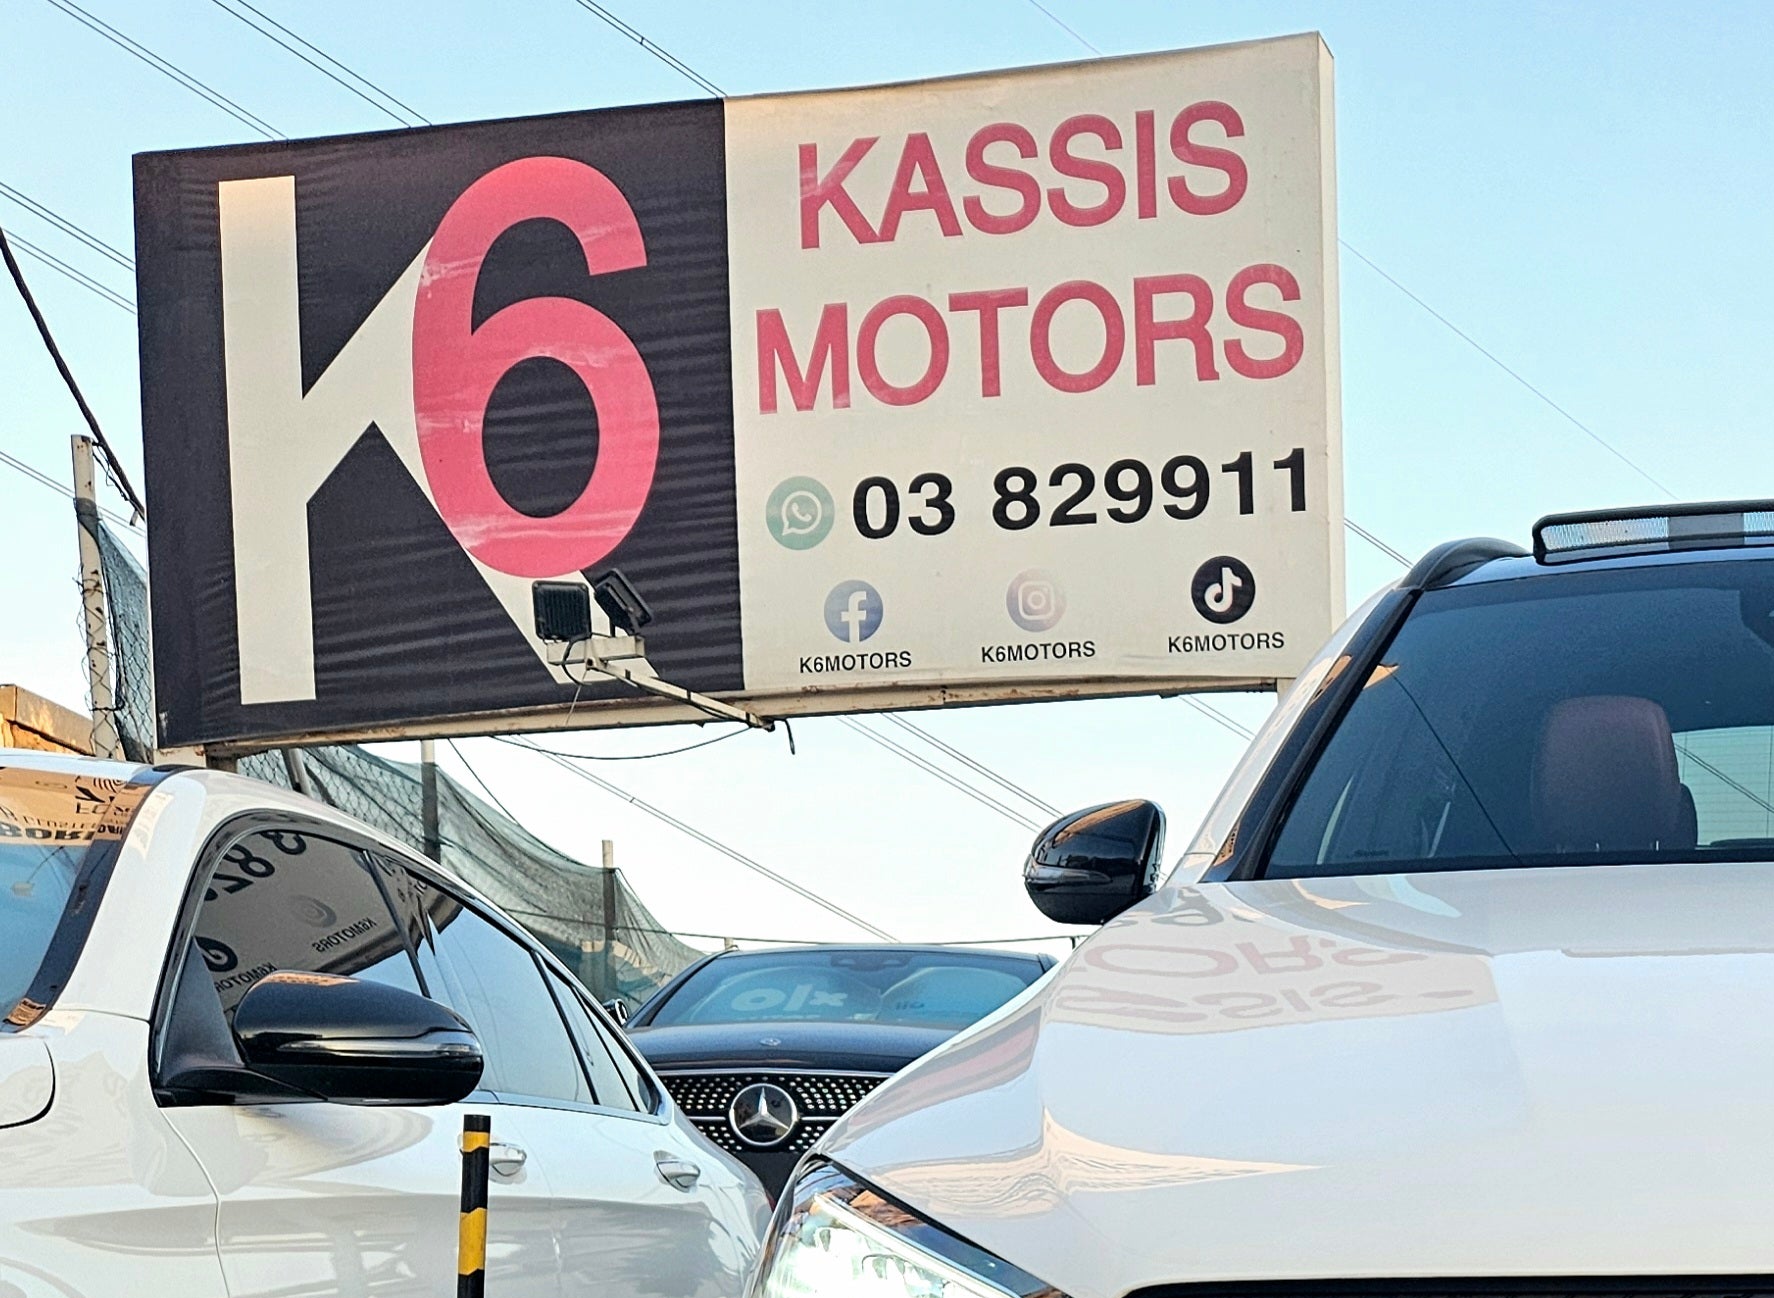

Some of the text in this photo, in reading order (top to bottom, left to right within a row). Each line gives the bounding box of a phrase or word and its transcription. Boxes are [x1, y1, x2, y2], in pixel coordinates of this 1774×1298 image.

[798, 101, 1249, 249] KASSIS
[756, 264, 1304, 415] MOTORS
[218, 156, 661, 705] K6
[853, 447, 1307, 539] 03 829911
[800, 651, 912, 674] K6MOTORS
[981, 641, 1096, 663] K6MOTORS
[1168, 632, 1285, 654] K6MOTORS
[730, 983, 848, 1011] olx
